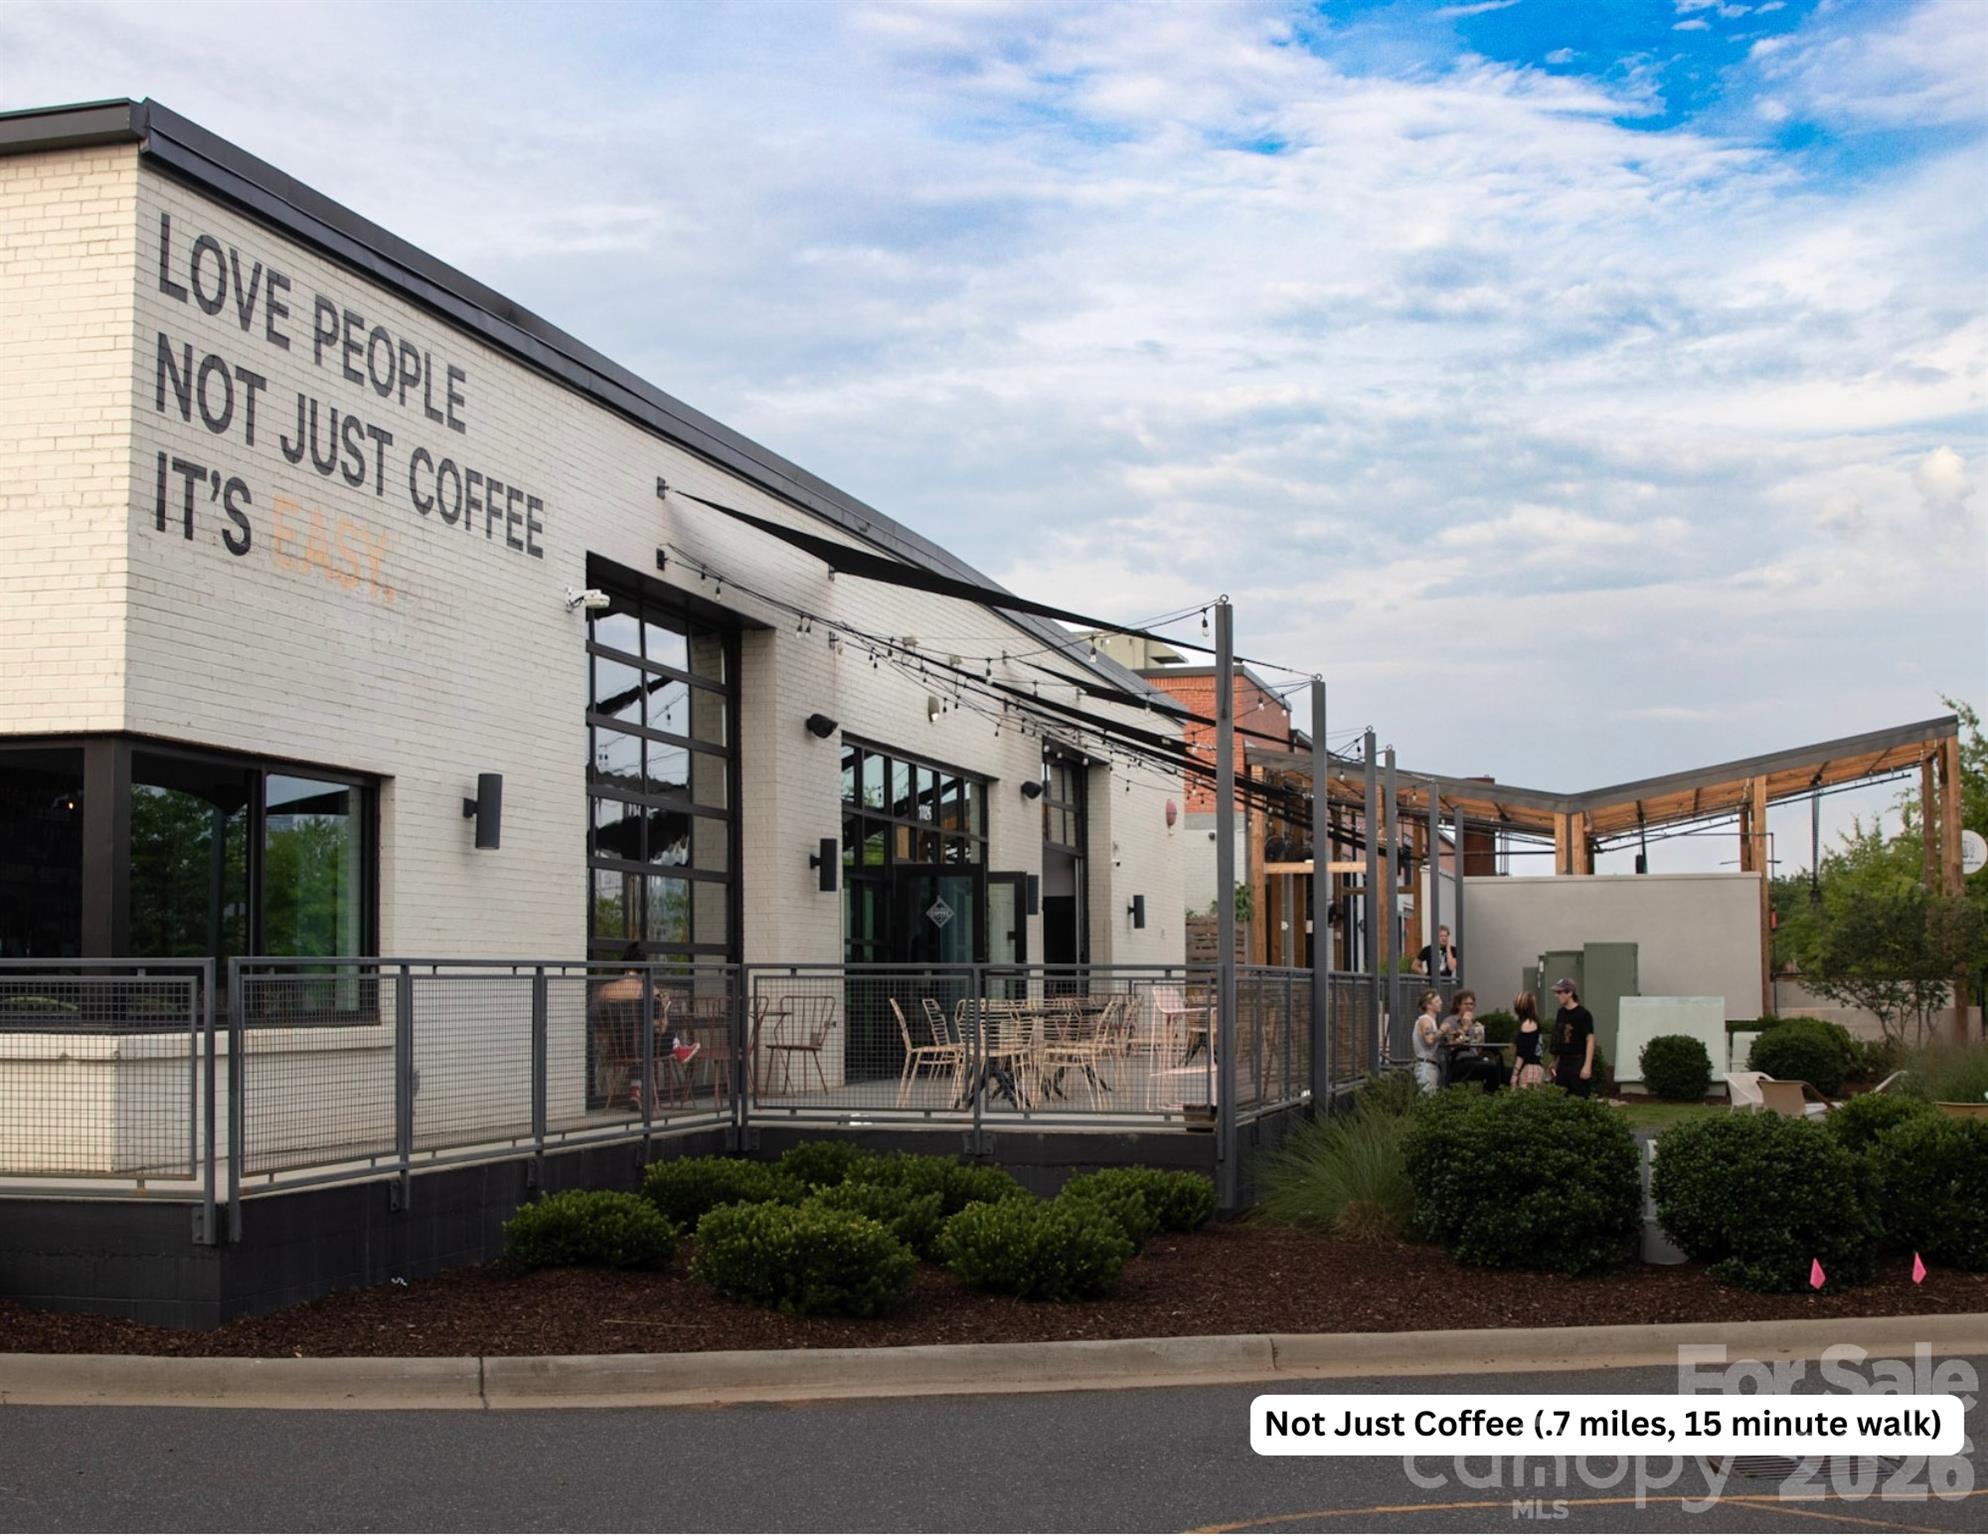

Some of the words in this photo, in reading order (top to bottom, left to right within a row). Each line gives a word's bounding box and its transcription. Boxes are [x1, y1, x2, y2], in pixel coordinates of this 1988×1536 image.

[159, 212, 291, 351] LOVE
[313, 294, 466, 434] PEOPLE
[154, 450, 252, 557] IT'S
[271, 496, 396, 602] EASY.
[155, 331, 267, 447] NOT
[279, 392, 393, 497] JUST
[409, 447, 543, 559] COFFEE
